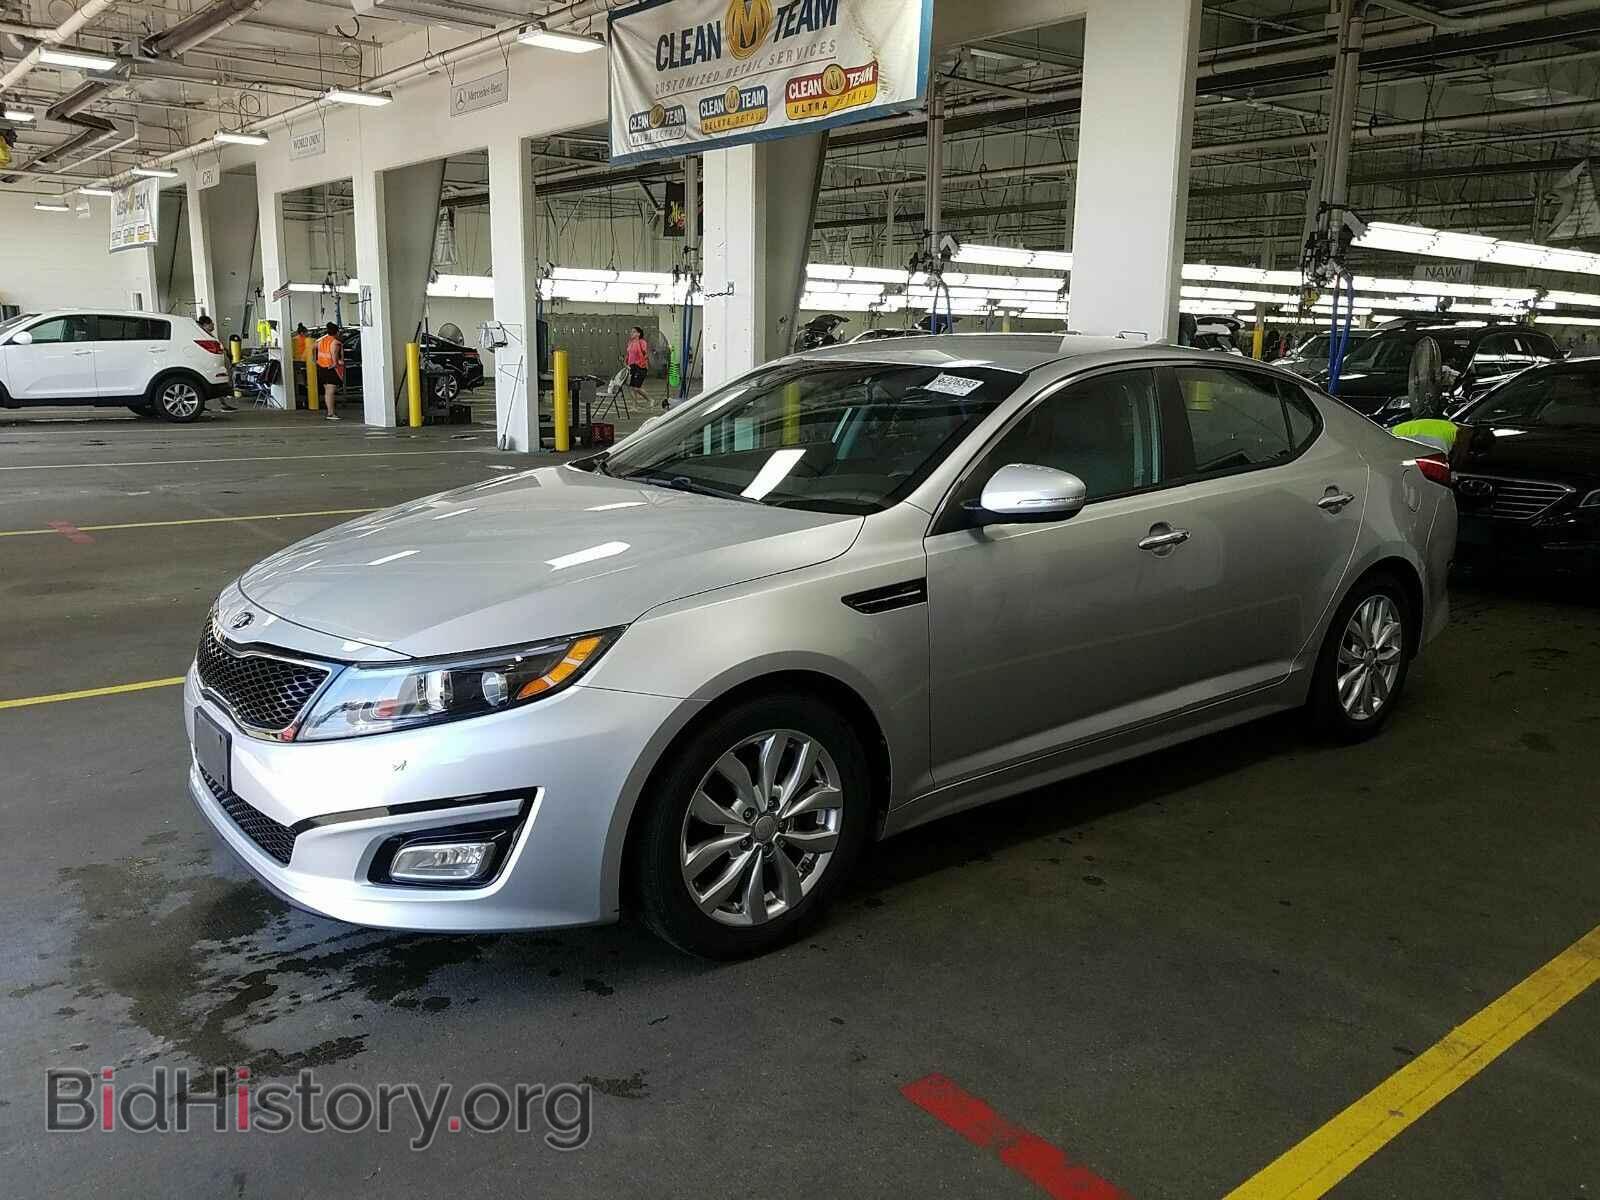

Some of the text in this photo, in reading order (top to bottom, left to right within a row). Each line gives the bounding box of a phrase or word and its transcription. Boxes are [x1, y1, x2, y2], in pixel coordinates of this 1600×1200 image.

[656, 20, 721, 71] CLEAN
[773, 0, 838, 43] TEAM
[655, 40, 836, 95] CUSTOMIZED DETAIL SERVICES
[789, 79, 822, 99] CLEAN
[847, 65, 873, 89] TEAM
[700, 98, 725, 117] CLEAN
[741, 90, 765, 108] TEAM
[794, 100, 828, 113] ULTRA
[631, 107, 685, 132] CLEAN TEAM
